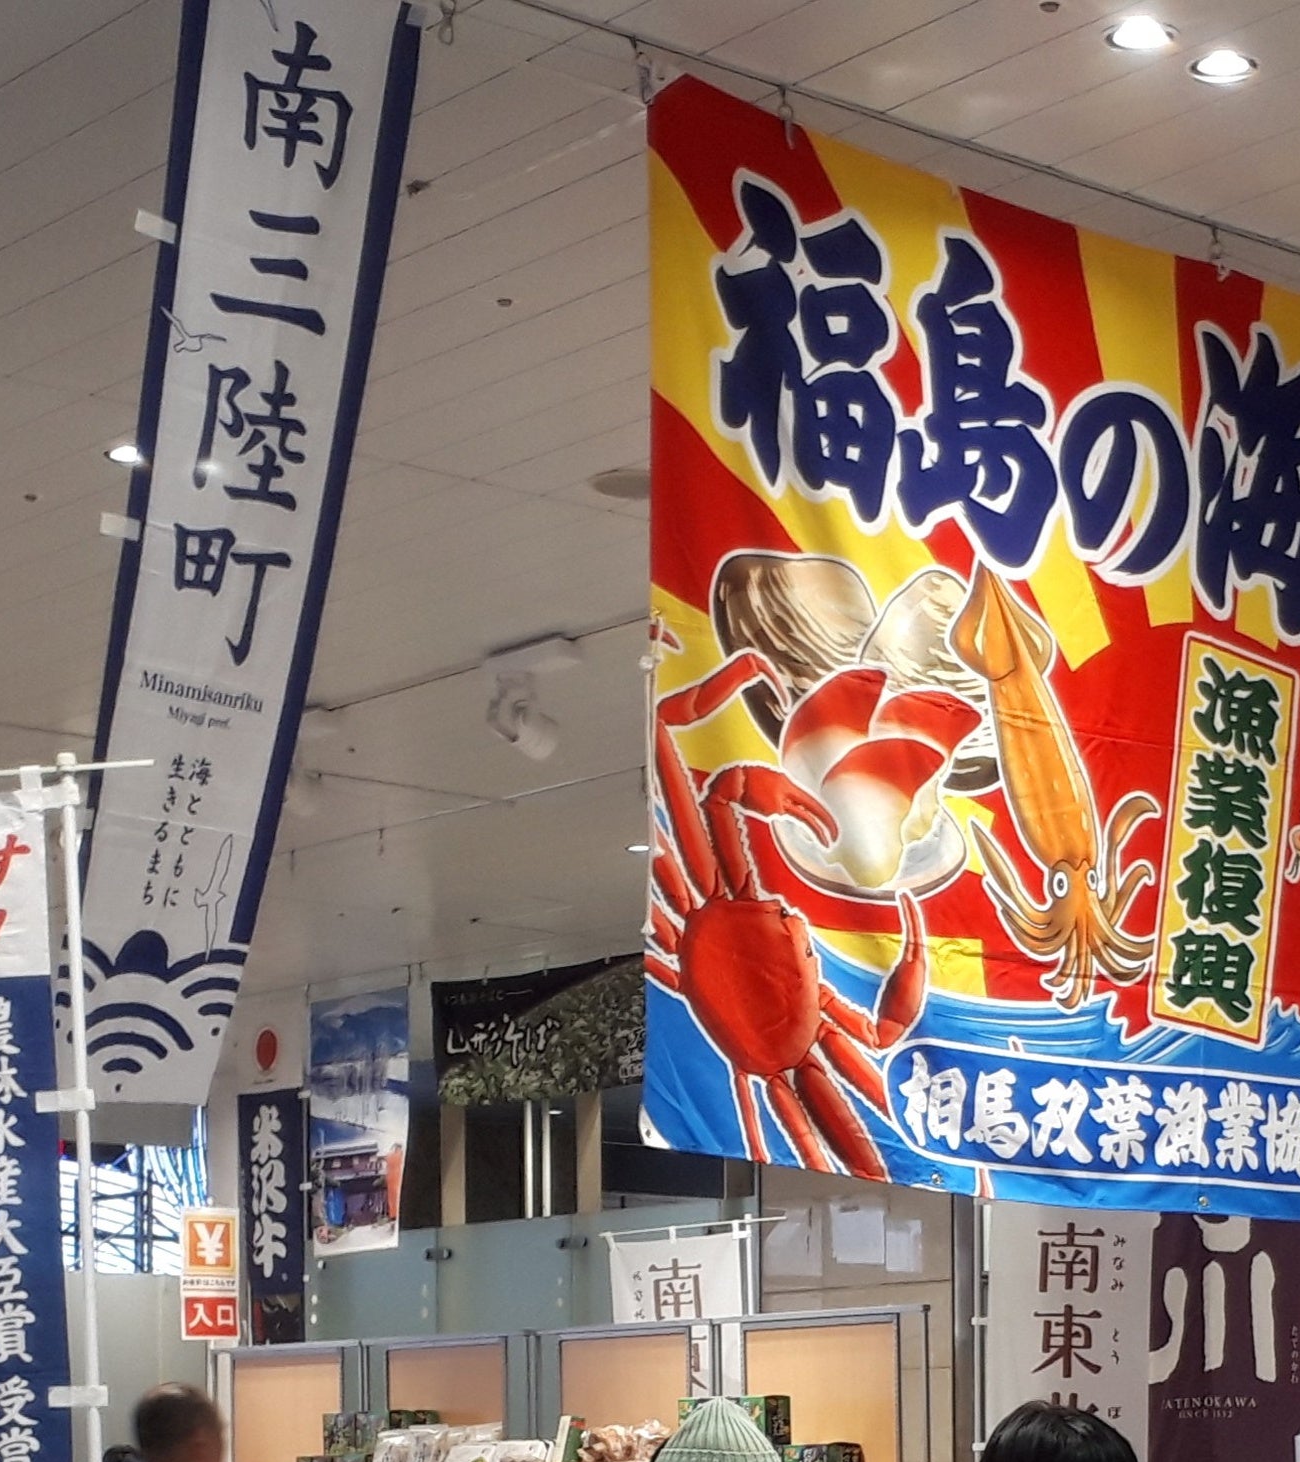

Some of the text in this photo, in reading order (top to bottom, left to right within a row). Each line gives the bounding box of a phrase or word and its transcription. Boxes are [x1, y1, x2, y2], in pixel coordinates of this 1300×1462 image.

[174, 21, 353, 666] 南三陸町
[139, 669, 264, 714] Minamisanriku
[142, 755, 186, 906] 生きるまち
[162, 758, 213, 908] 海とともに
[1164, 655, 1278, 1023] 漁業復興
[250, 1104, 288, 1279] 米沢牛
[1112, 1234, 1126, 1292] みなみ
[188, 1303, 236, 1329] 入口
